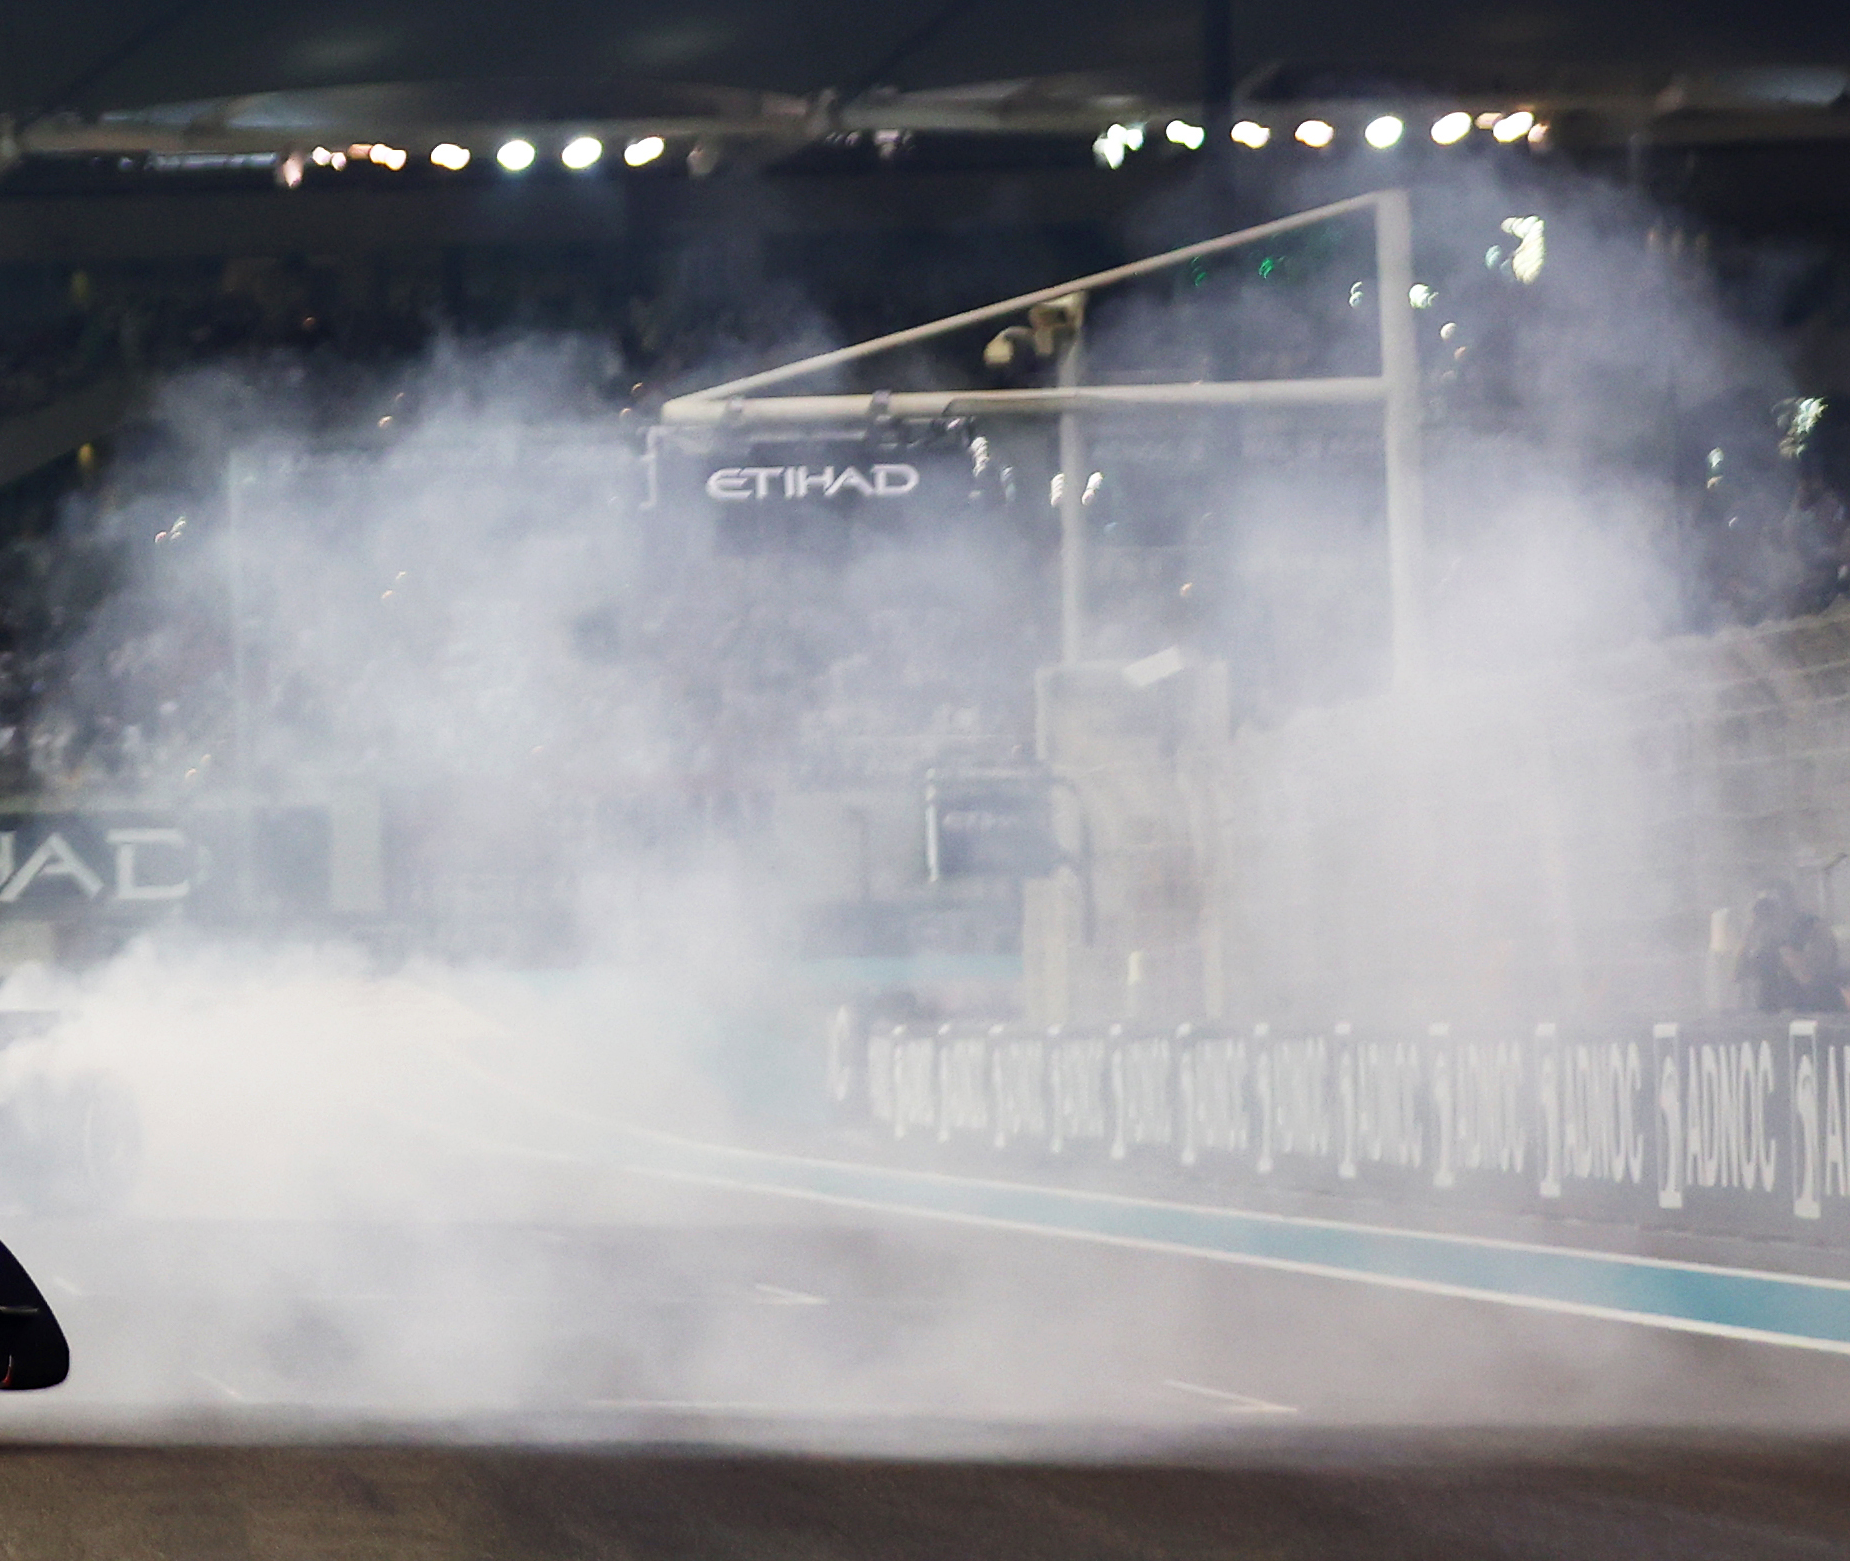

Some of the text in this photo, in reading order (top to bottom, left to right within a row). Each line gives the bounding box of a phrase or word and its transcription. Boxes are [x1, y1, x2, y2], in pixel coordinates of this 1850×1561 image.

[705, 463, 920, 501] ETIHAD
[1565, 1041, 1644, 1185] ADNOC
[1687, 1040, 1777, 1193] ADNOC
